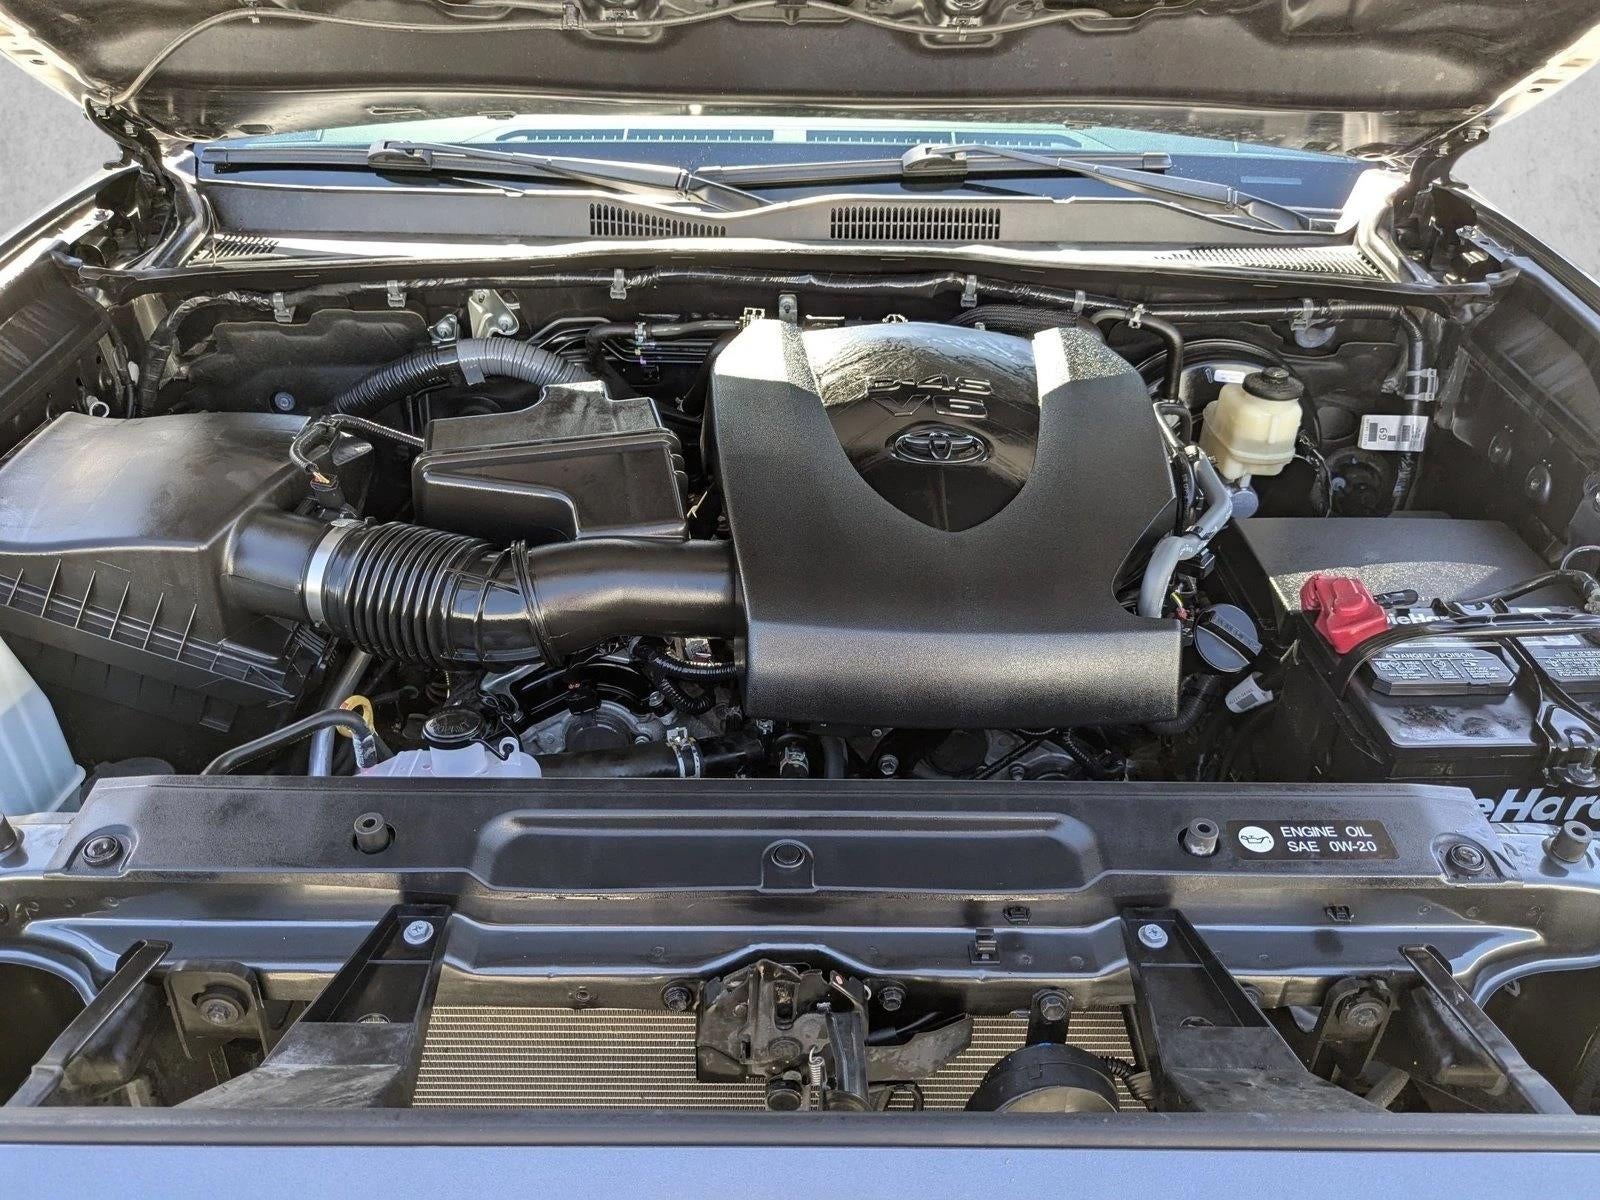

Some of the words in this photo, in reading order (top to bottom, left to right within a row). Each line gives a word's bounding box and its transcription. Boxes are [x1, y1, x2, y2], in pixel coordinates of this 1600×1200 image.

[871, 394, 989, 419] V6
[1279, 826, 1338, 838] ENGINE
[1345, 826, 1373, 837] OIL
[1287, 840, 1321, 852] SAE
[1328, 840, 1378, 852] 0W-20
